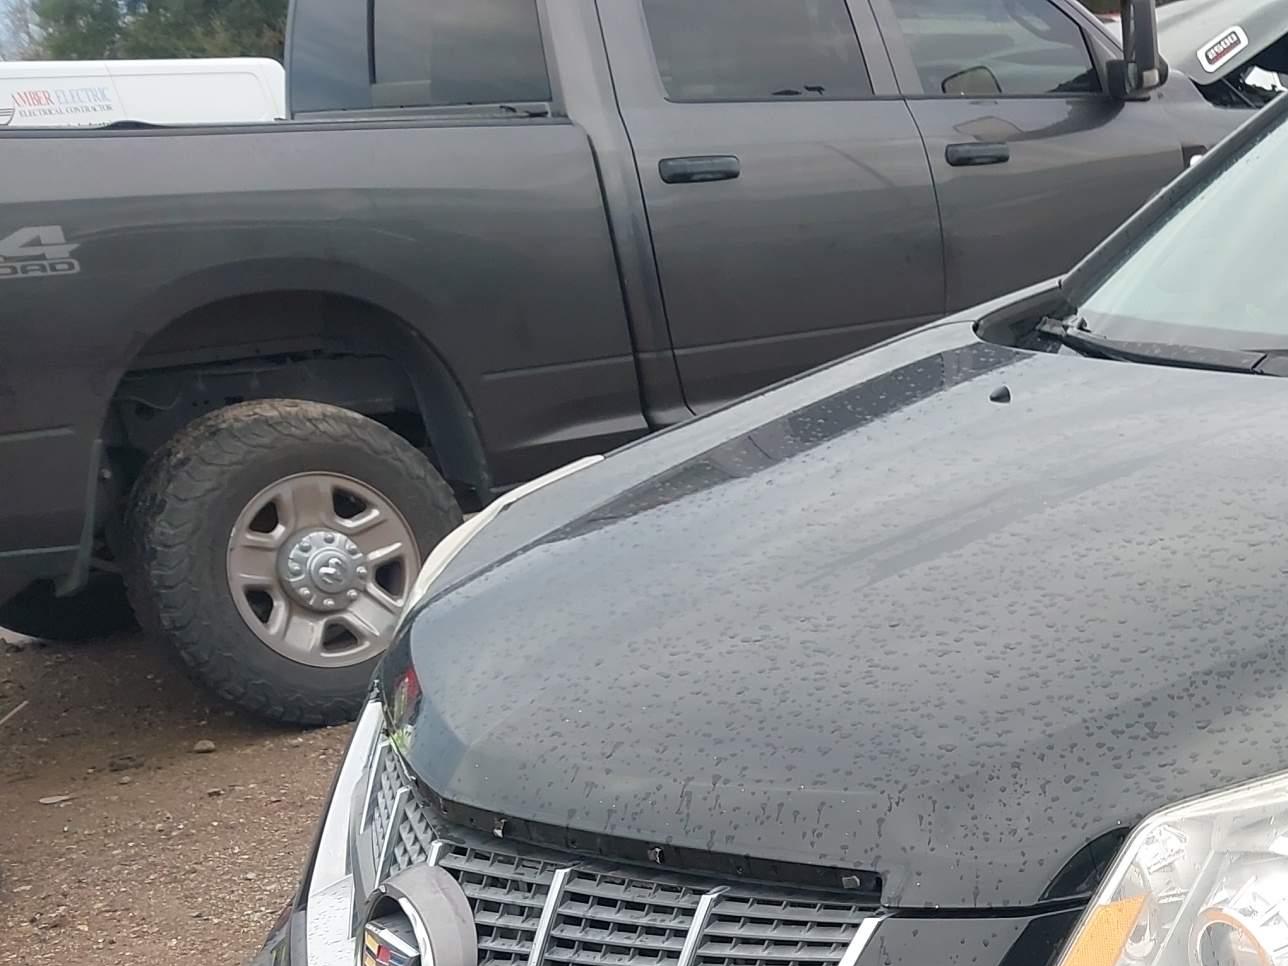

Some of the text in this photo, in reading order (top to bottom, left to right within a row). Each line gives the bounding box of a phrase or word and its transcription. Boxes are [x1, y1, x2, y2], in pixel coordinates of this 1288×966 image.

[11, 87, 112, 107] AMBER ELECTRIC
[18, 107, 64, 118] ELECTRICAL
